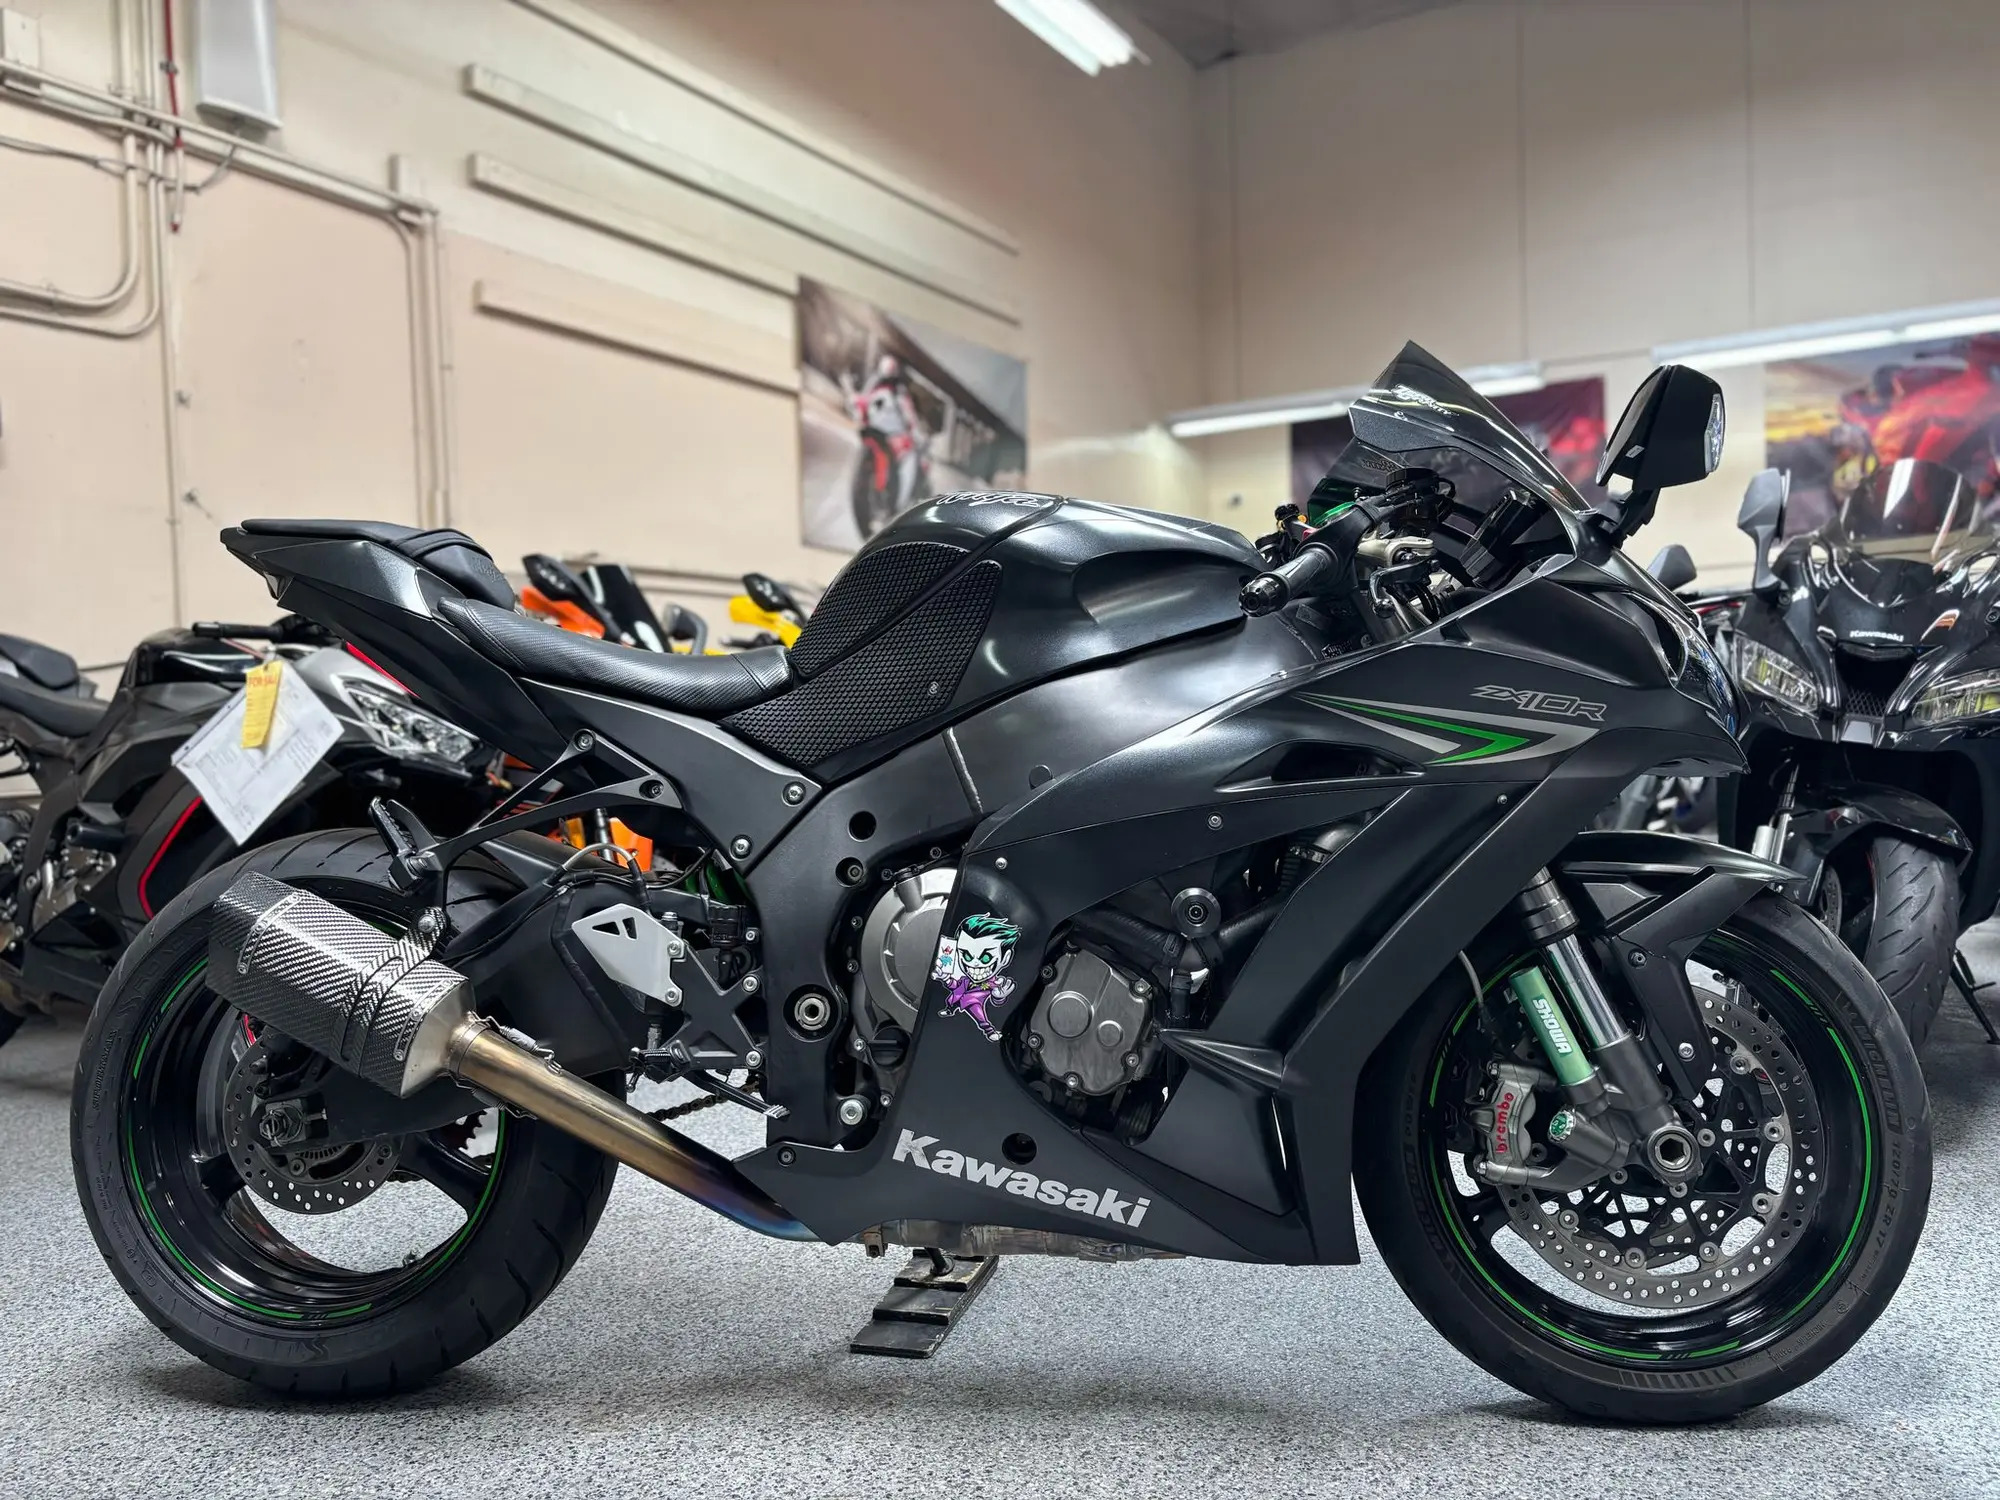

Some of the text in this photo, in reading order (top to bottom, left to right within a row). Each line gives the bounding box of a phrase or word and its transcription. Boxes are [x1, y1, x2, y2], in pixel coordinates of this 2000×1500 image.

[1849, 630, 1905, 643] Kawasaki
[1470, 684, 1608, 722] ZX10R
[1532, 997, 1573, 1054] SHOWA
[1853, 1024, 1901, 1128] MICHELIN
[1495, 1092, 1516, 1154] brembo
[892, 1128, 1151, 1228] Kawasaki
